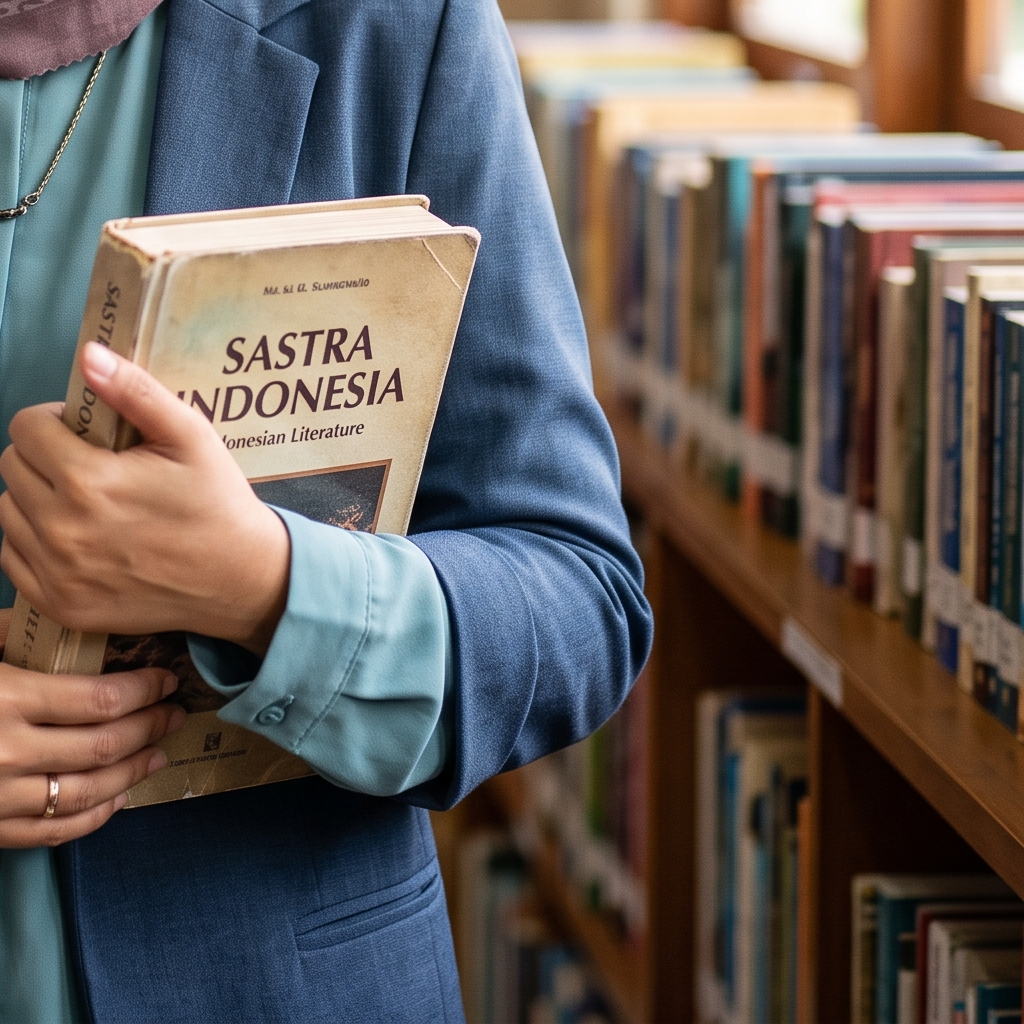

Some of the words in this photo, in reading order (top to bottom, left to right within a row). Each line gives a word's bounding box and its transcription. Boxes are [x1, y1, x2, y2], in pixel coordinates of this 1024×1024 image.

[222, 325, 373, 375] SASTRA
[222, 430, 286, 450] onesian
[290, 423, 365, 443] Literature
